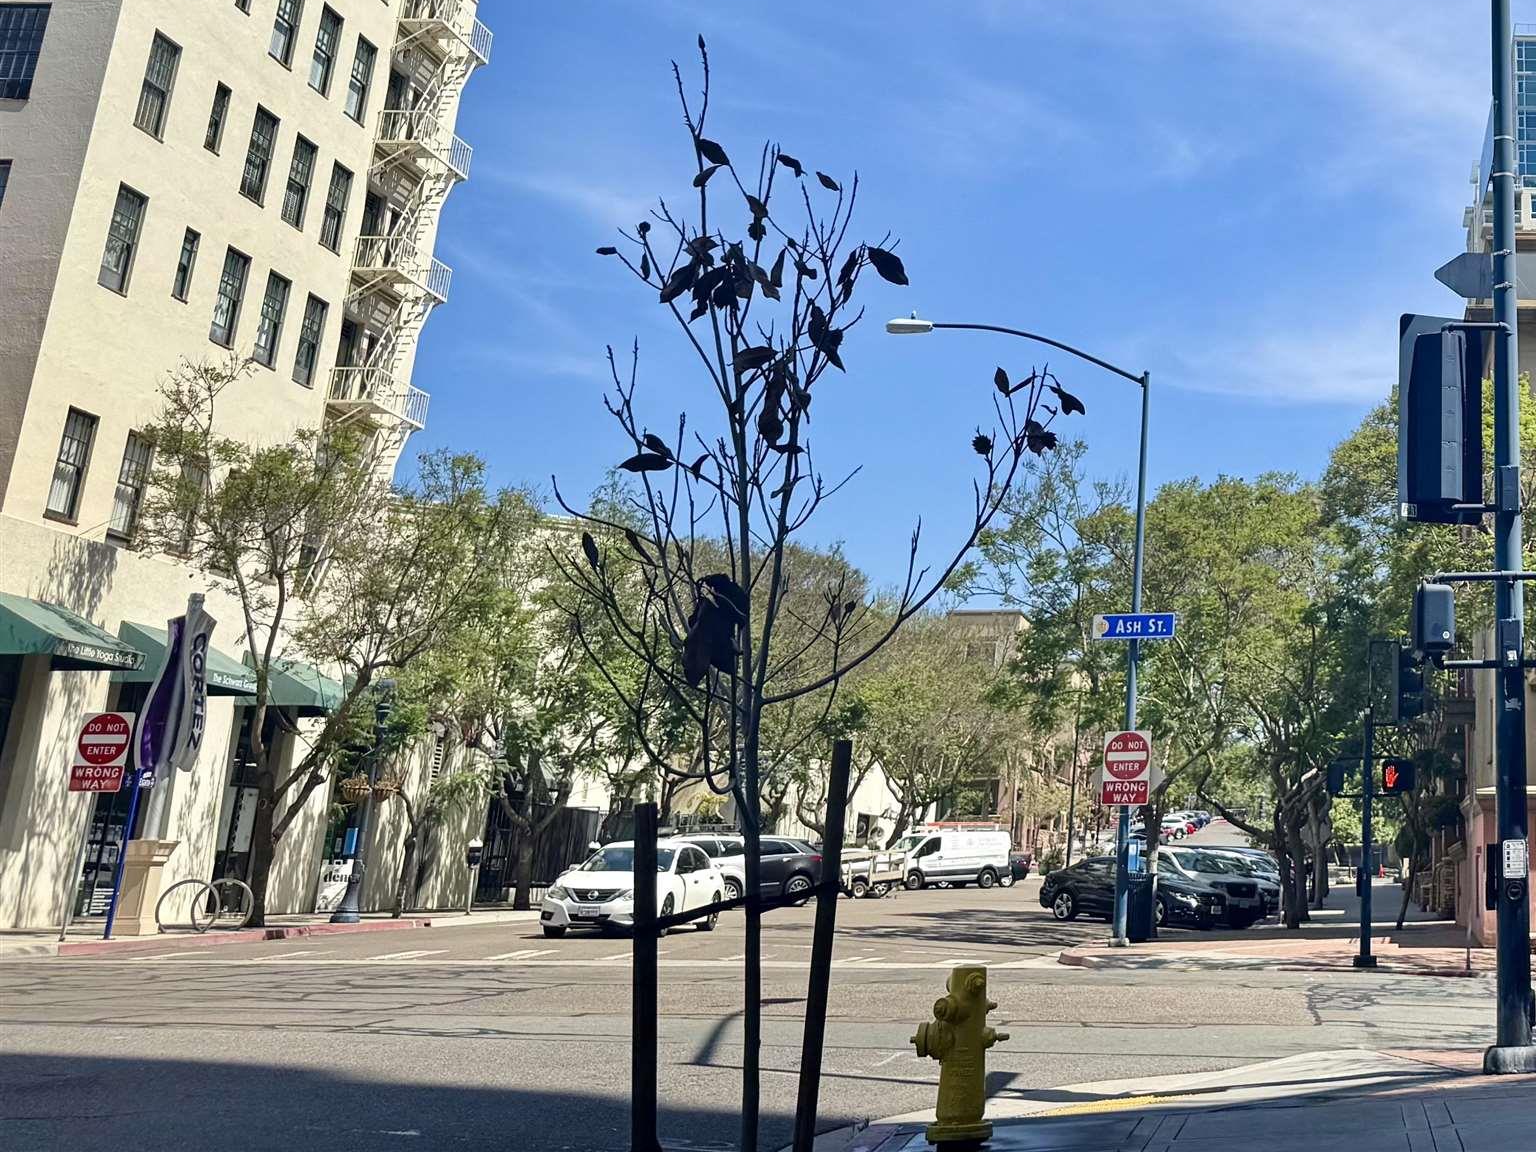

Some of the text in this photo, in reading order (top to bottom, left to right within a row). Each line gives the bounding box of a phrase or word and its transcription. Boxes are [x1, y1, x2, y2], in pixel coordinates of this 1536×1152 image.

[96, 648, 114, 662] Yoga
[187, 632, 207, 750] CORTEZ
[88, 723, 127, 732] DO NOT
[1111, 740, 1144, 750] DO NOT
[87, 746, 116, 755] ENTER
[1113, 762, 1140, 771] ENTER
[75, 767, 119, 778] WRONG
[82, 779, 108, 789] WAY
[1106, 782, 1146, 792] WRONG
[1113, 793, 1136, 803] WAY
[323, 871, 349, 882] den
